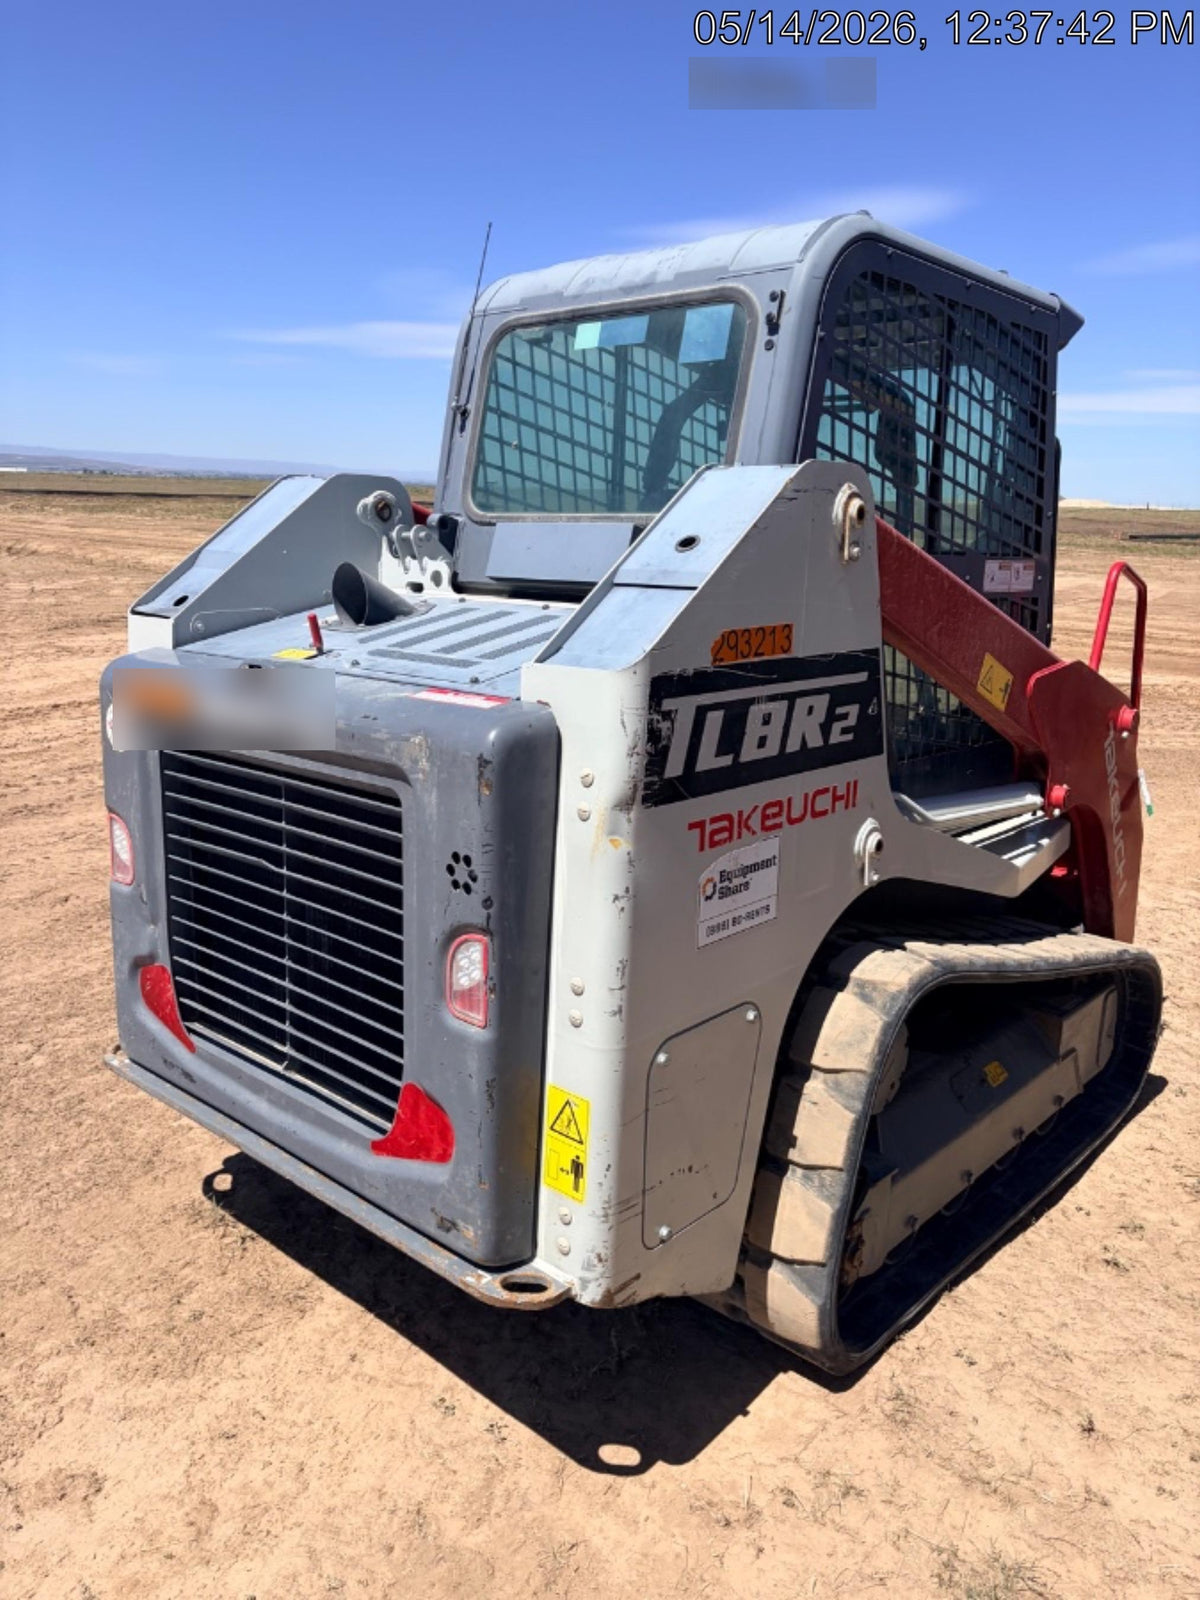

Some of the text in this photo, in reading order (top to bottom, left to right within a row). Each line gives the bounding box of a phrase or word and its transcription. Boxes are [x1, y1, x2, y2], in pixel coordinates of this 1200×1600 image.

[712, 623, 792, 663] 293213
[661, 671, 869, 779] TL8R2
[719, 854, 777, 884] Equipment
[718, 880, 751, 900] Share
